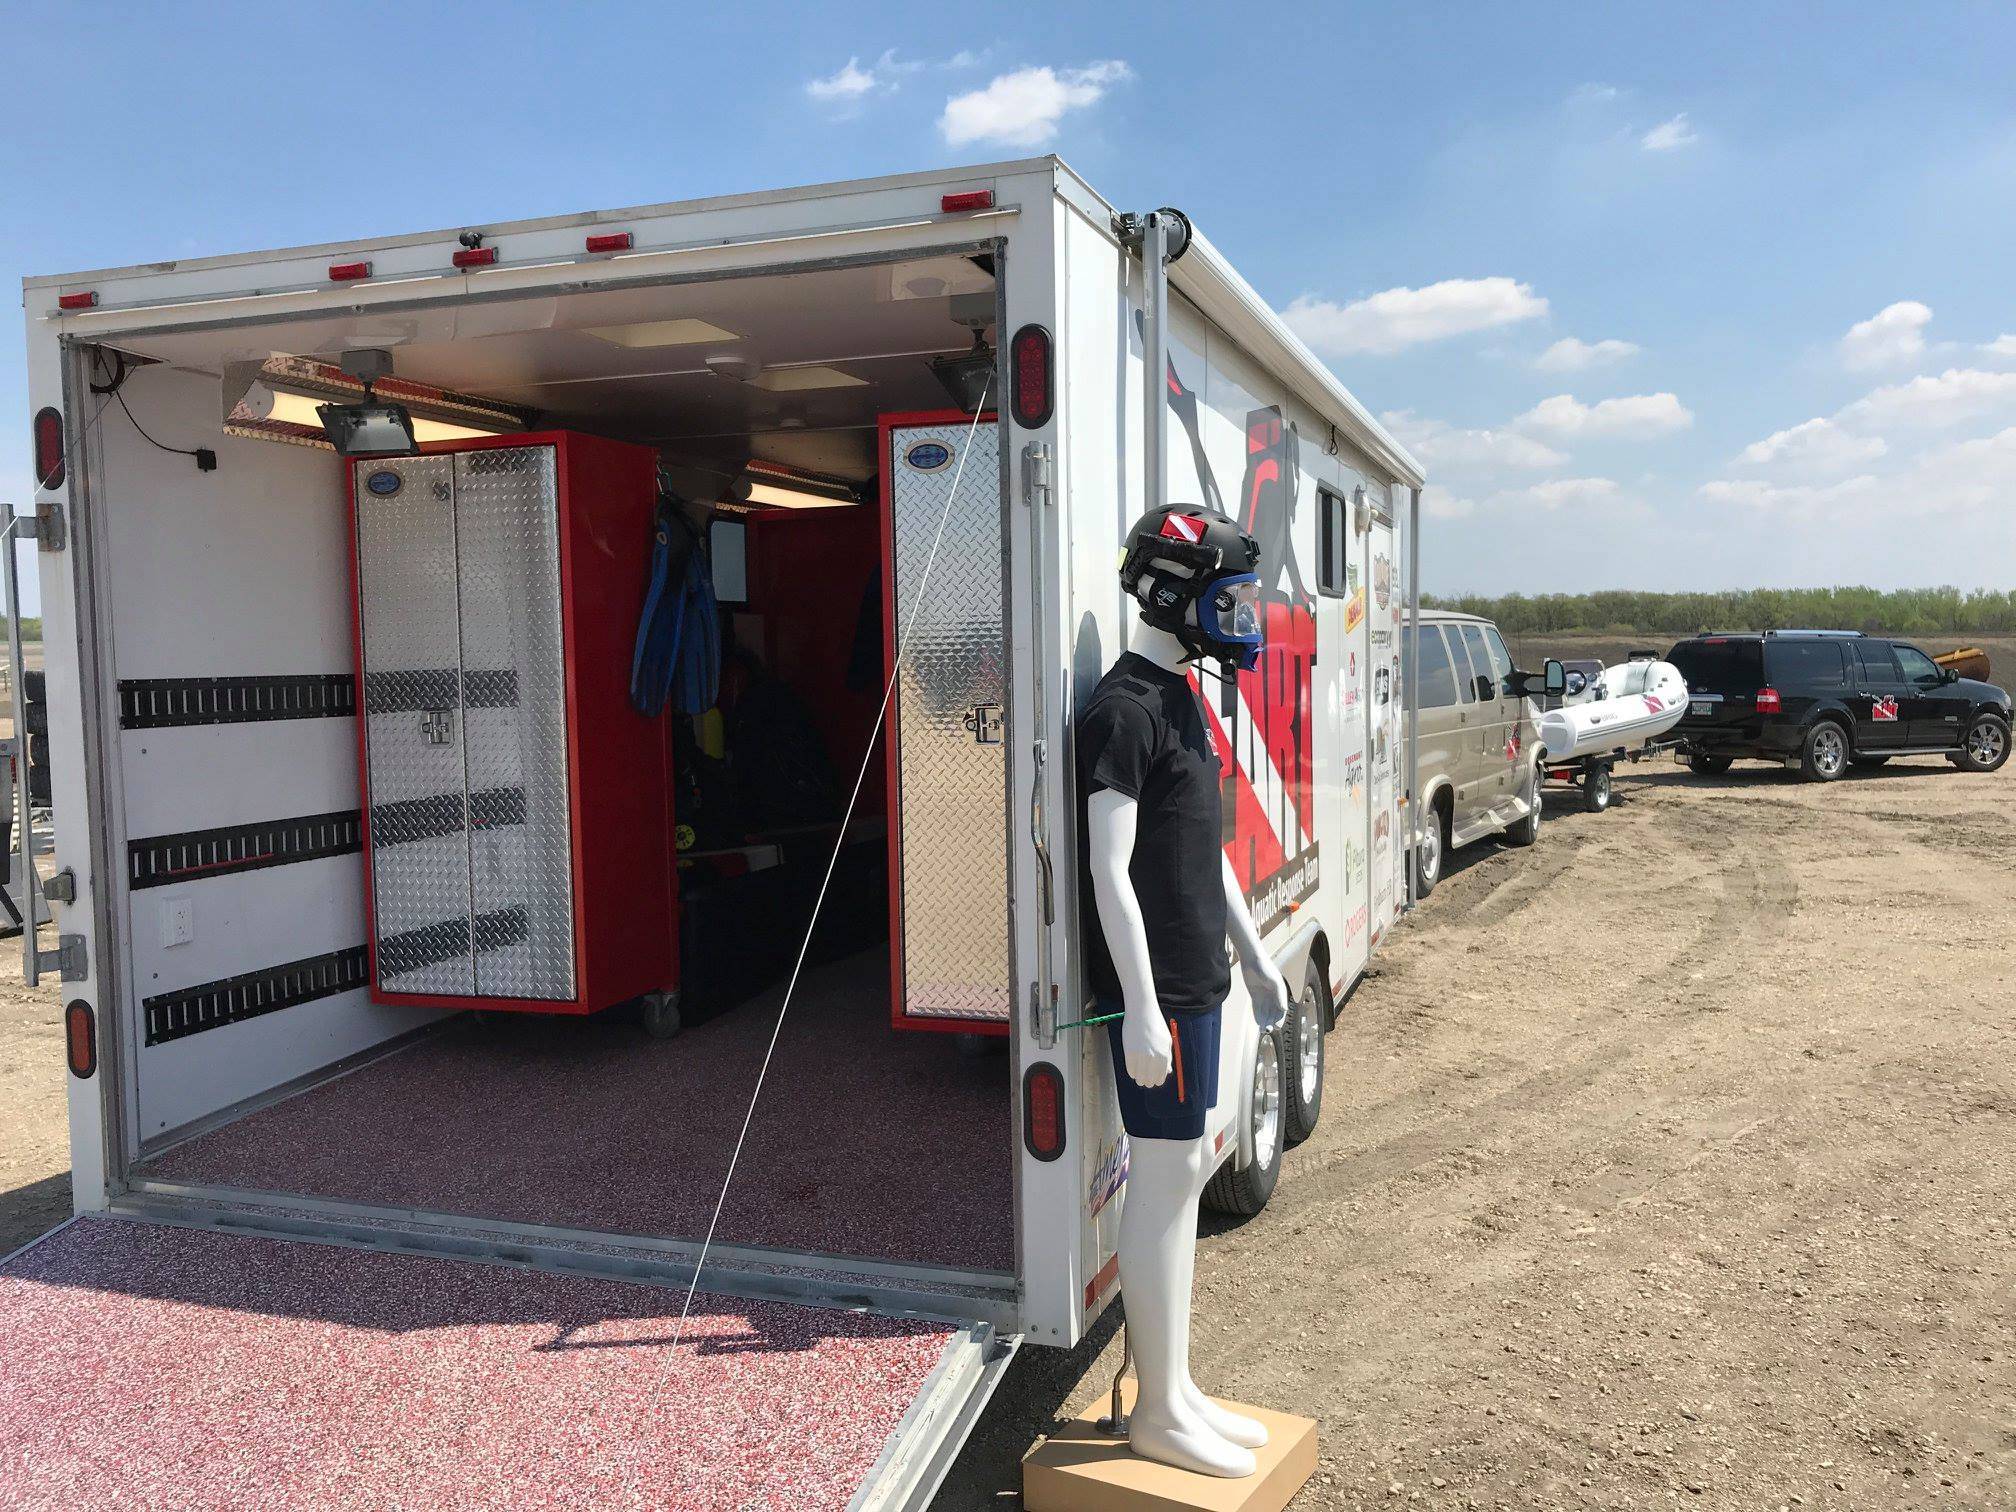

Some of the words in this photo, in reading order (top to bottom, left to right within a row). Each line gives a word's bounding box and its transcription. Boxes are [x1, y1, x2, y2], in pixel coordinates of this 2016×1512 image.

[1251, 881, 1277, 937] Aquatic
[1277, 876, 1304, 911] Response
[1304, 856, 1319, 888] Team
